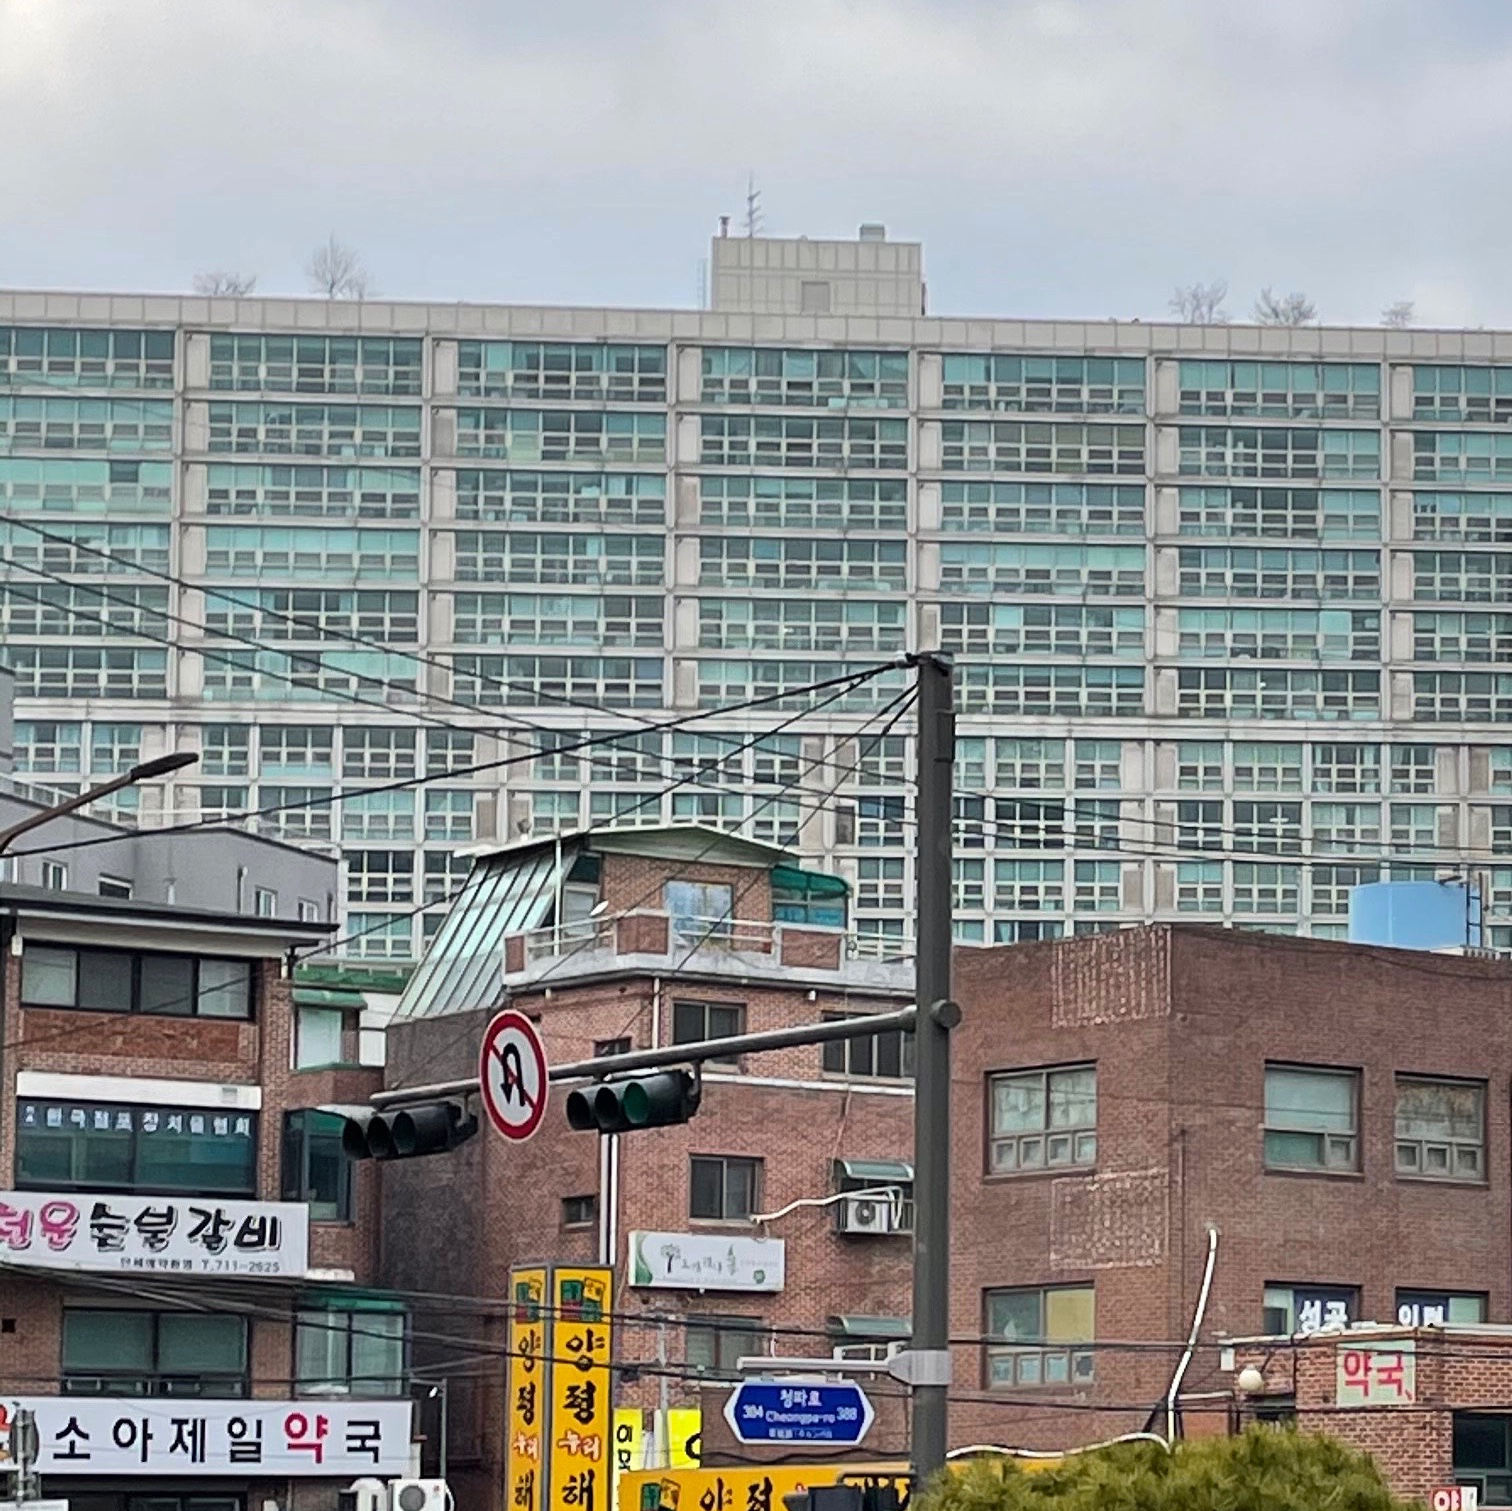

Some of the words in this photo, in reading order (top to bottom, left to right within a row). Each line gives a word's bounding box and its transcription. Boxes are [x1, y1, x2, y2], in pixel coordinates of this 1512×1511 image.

[1343, 1352, 1405, 1398] 약국
[780, 1389, 823, 1409] 청파로
[766, 1411, 836, 1425] Cheongpa-ro
[53, 1411, 382, 1464] 소아제일약국
